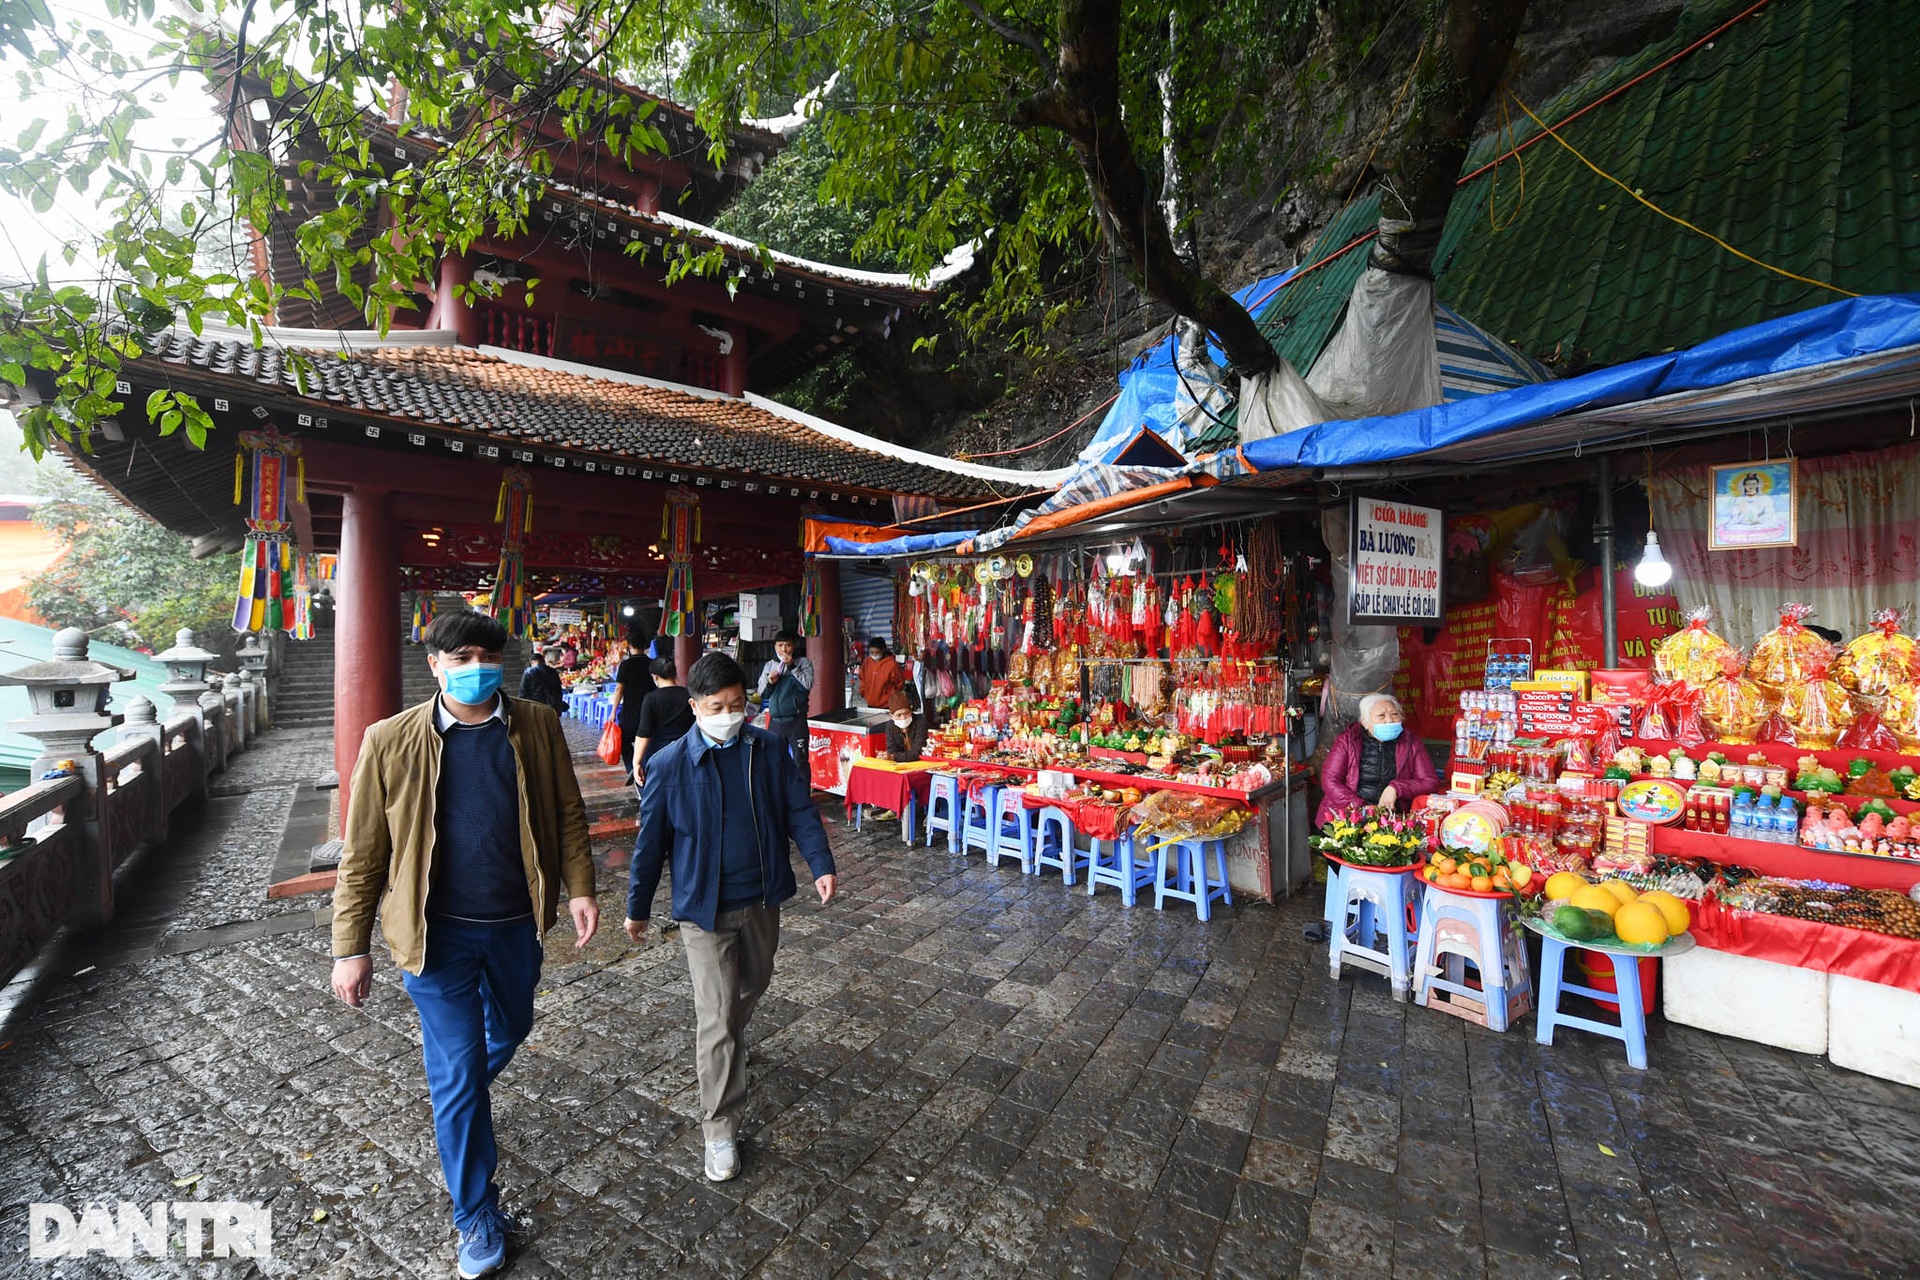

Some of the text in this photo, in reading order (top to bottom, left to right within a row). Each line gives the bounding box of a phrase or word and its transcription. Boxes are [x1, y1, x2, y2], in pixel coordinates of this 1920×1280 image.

[1375, 503, 1427, 528] CỬA HÀNG
[1360, 523, 1416, 557] BÀ LƯƠNG
[757, 625, 779, 639] TP
[1624, 636, 1647, 658] VÀ
